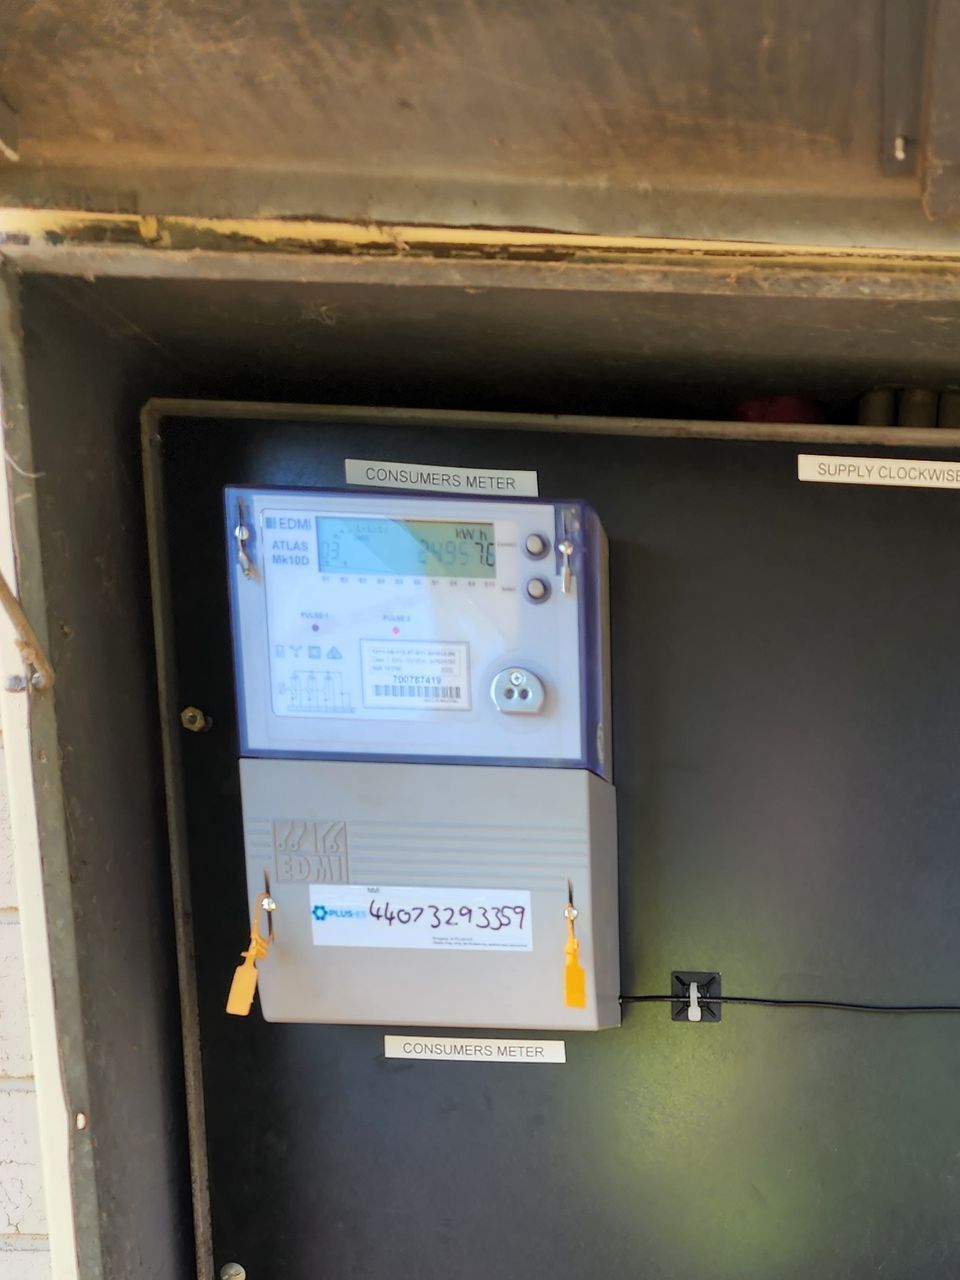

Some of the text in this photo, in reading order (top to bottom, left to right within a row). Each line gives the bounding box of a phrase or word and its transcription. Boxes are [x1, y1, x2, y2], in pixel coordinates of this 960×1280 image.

[817, 462, 874, 478] SUPPLY
[366, 467, 516, 490] CONSUMERS METER
[279, 518, 312, 530] EDMI
[272, 540, 309, 551] ATLAS
[282, 855, 344, 881] EDMI
[402, 1042, 545, 1058] CONSUMERS METER
